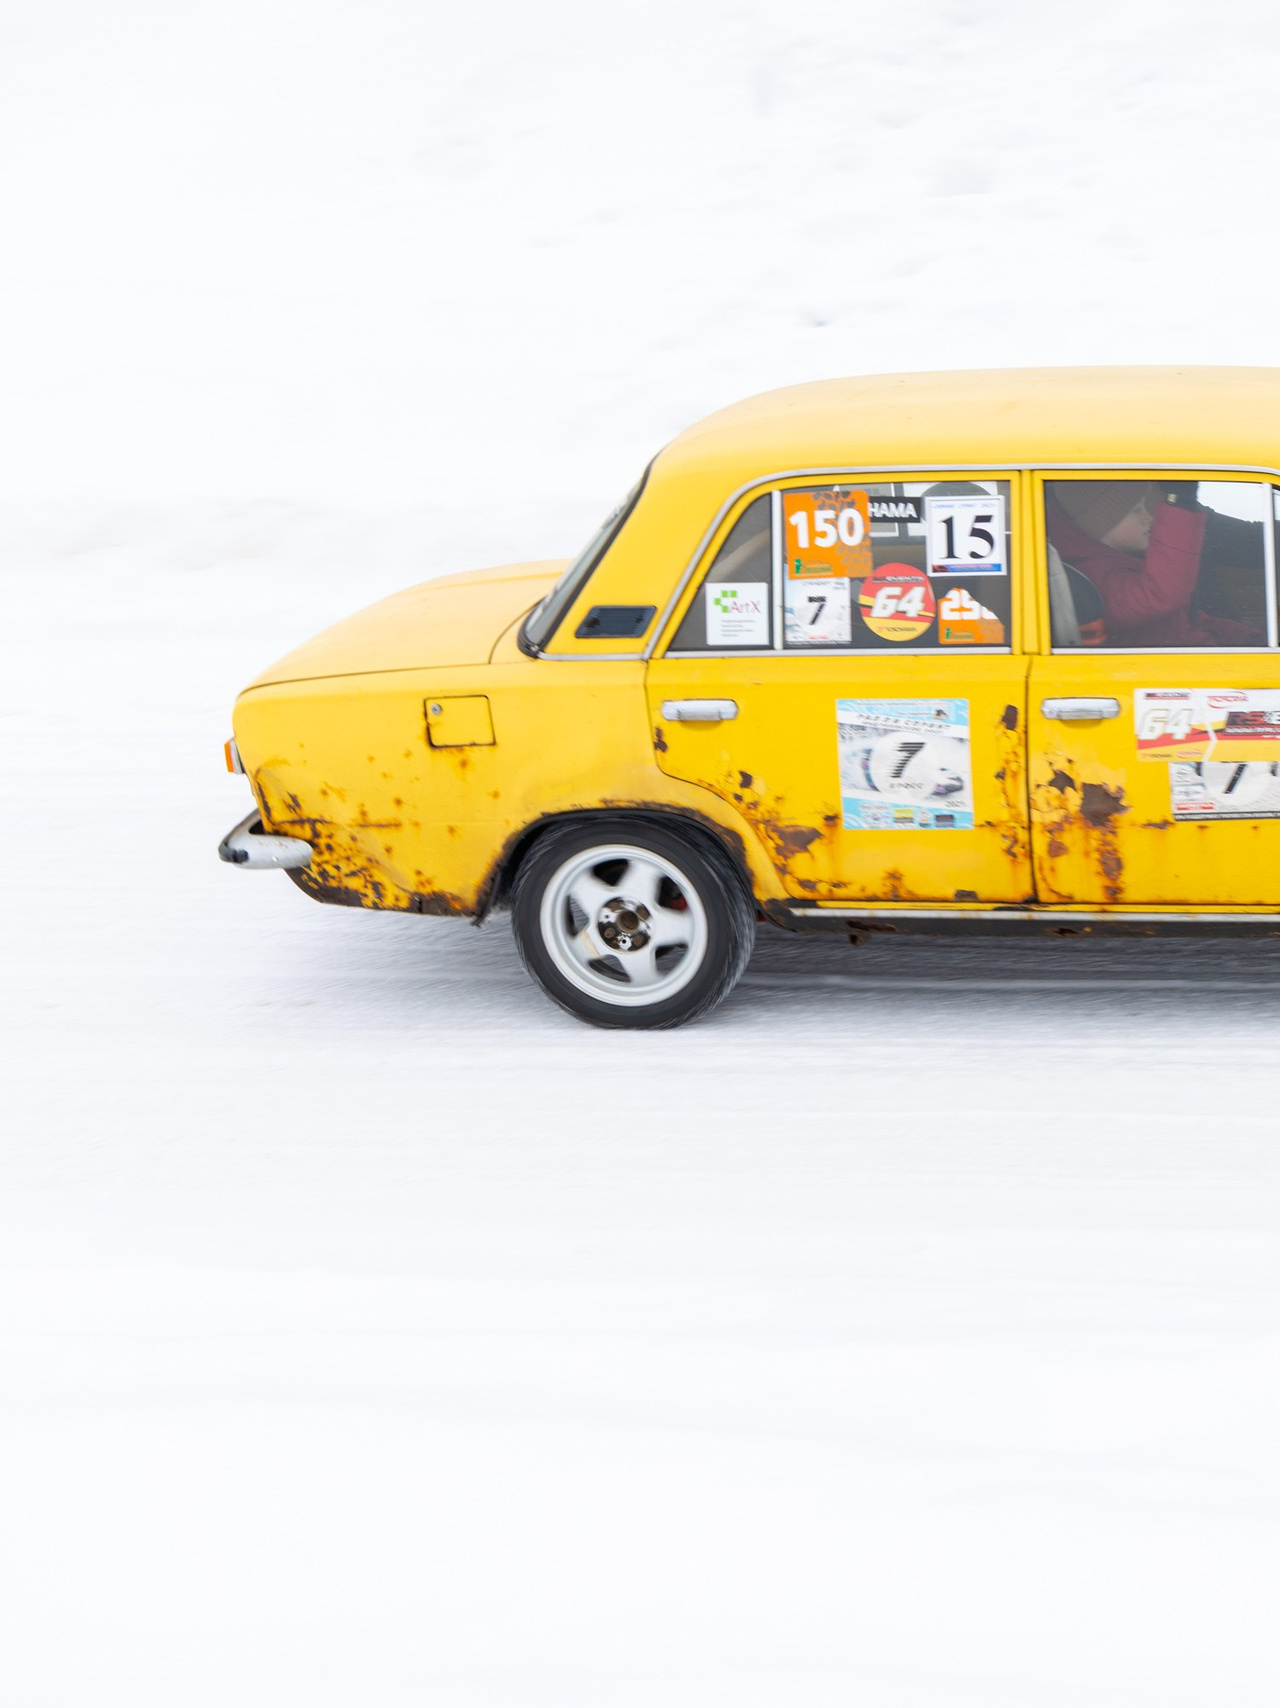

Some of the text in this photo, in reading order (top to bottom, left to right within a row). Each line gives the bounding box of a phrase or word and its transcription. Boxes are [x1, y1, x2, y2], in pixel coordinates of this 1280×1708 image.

[868, 502, 918, 518] HAMA
[788, 508, 865, 549] 150
[937, 514, 995, 560] 15
[807, 596, 827, 626] 7
[870, 586, 927, 618] 64
[1137, 708, 1194, 740] 64
[890, 742, 926, 778] 7
